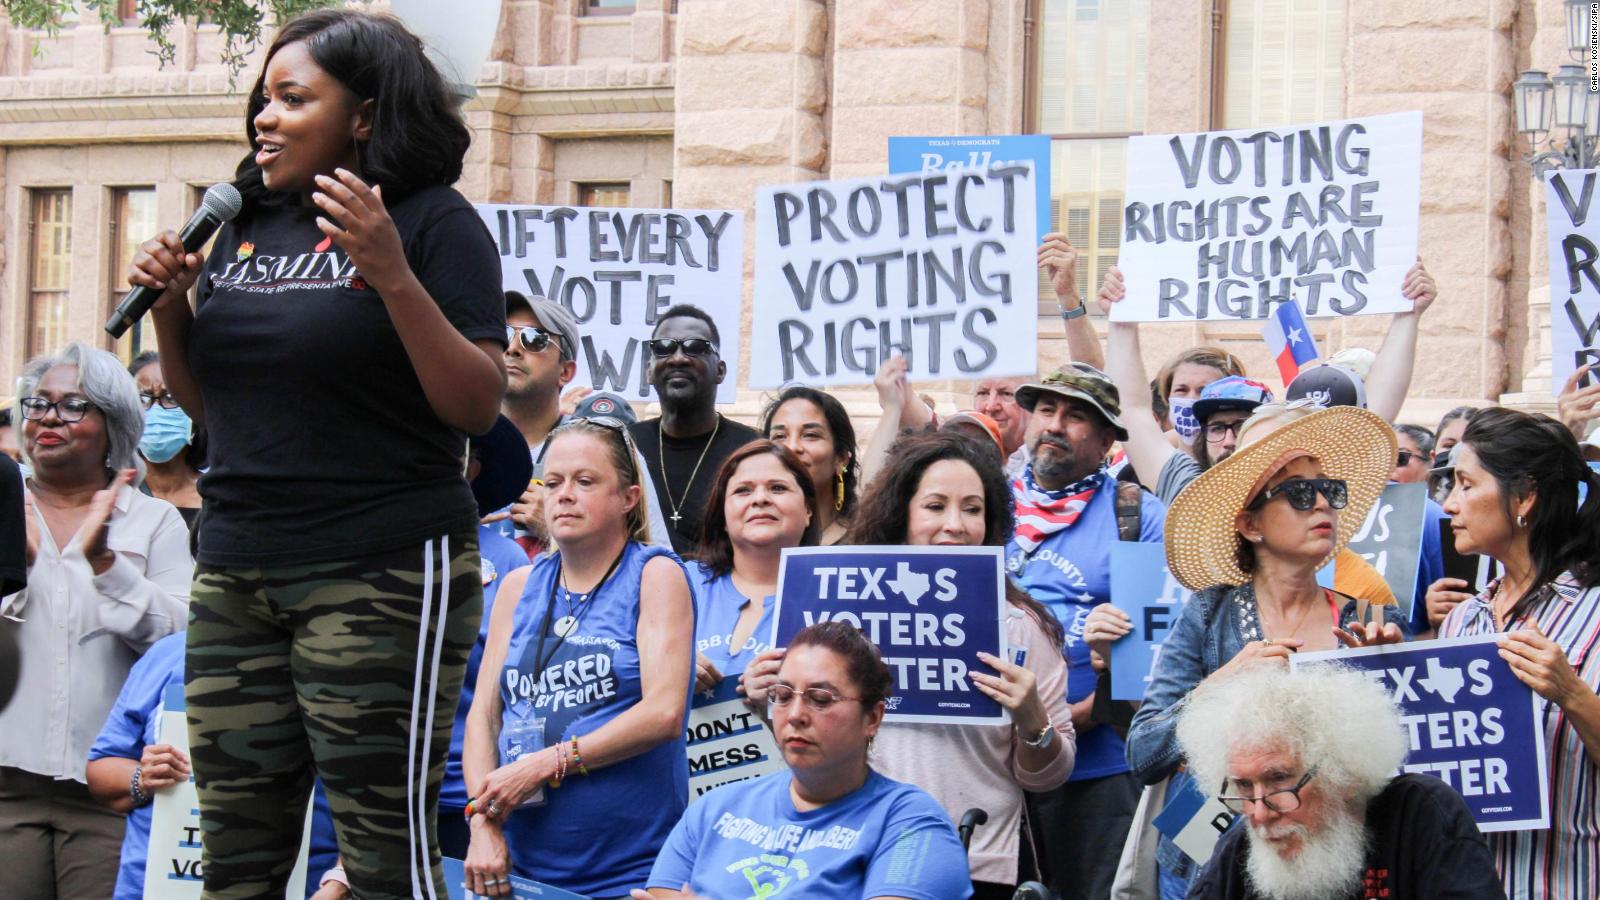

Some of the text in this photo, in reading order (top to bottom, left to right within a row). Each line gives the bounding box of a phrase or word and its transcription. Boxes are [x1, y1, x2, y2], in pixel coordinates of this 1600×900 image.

[957, 138, 1000, 147] DEMOCRATS
[1169, 123, 1370, 189] VOTING
[774, 166, 1030, 246] PROTECT
[1125, 180, 1383, 244] RIGHTS ARE
[474, 207, 733, 272] IFT EVERY
[1198, 228, 1376, 281] HUMAN
[210, 251, 357, 285] JASMIN
[276, 278, 352, 292] REPRESENTATIVE
[782, 241, 1012, 311] VOTING
[523, 265, 675, 326] VOTE
[1158, 270, 1367, 320] RIGHTS
[778, 307, 997, 381] RIGHTS
[506, 653, 611, 705] POWERED
[535, 677, 616, 712] BY PEOPLE
[1399, 707, 1505, 750] TERS
[689, 744, 762, 777] MESS
